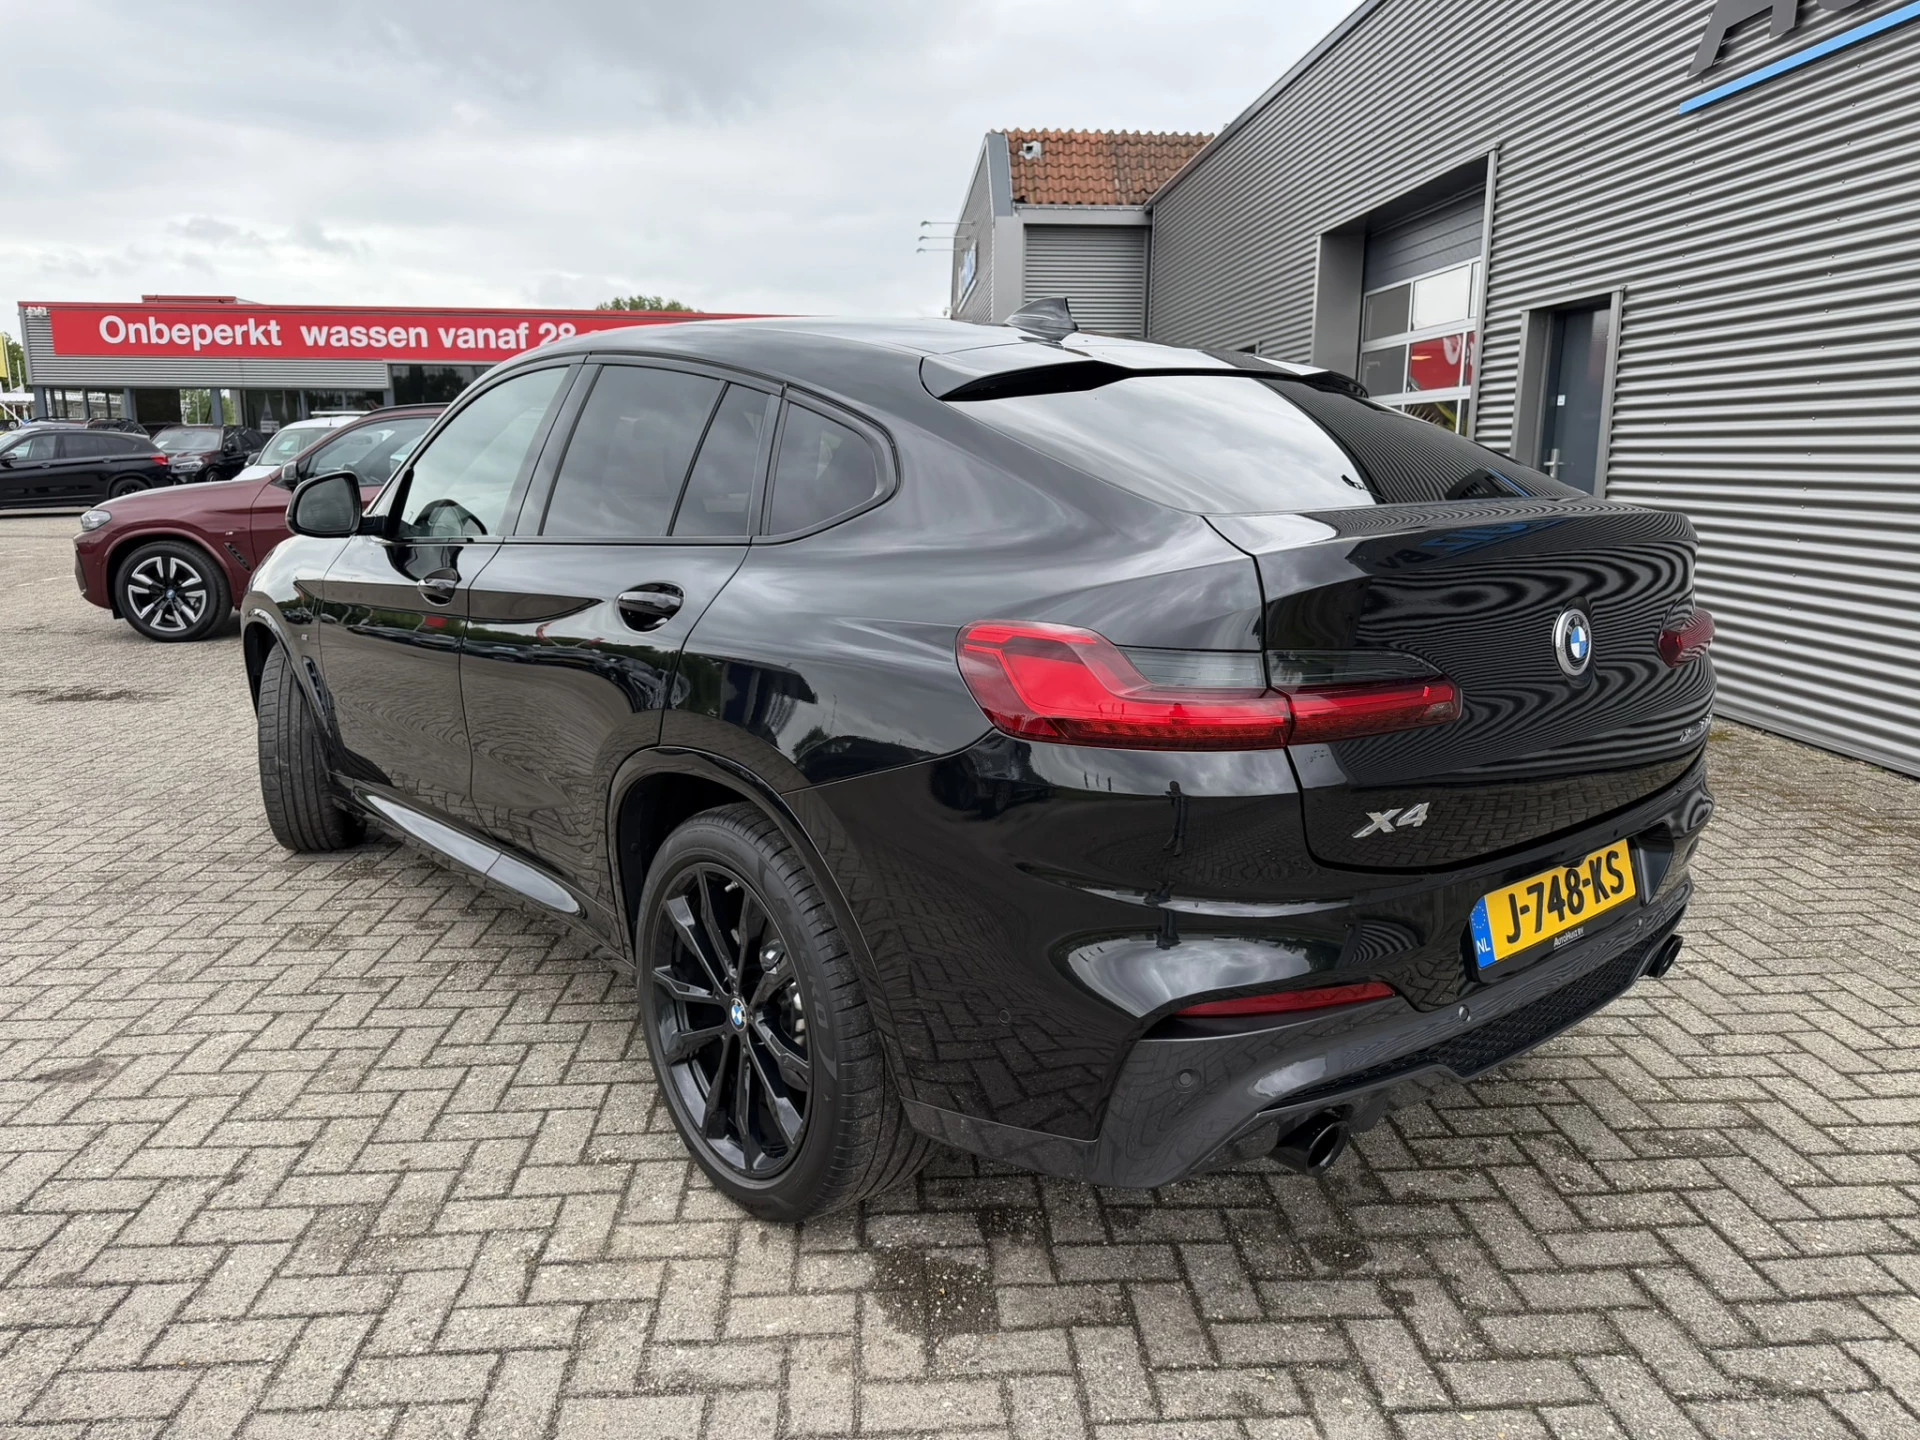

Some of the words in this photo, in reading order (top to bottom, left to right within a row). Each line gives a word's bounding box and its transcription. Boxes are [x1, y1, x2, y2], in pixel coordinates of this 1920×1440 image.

[99, 315, 282, 351] Onbeperkt
[300, 324, 428, 348] wassen
[438, 322, 529, 349] vanaf
[1352, 802, 1430, 838] X4
[1506, 850, 1625, 944] J-748-KS
[1476, 936, 1491, 955] NL
